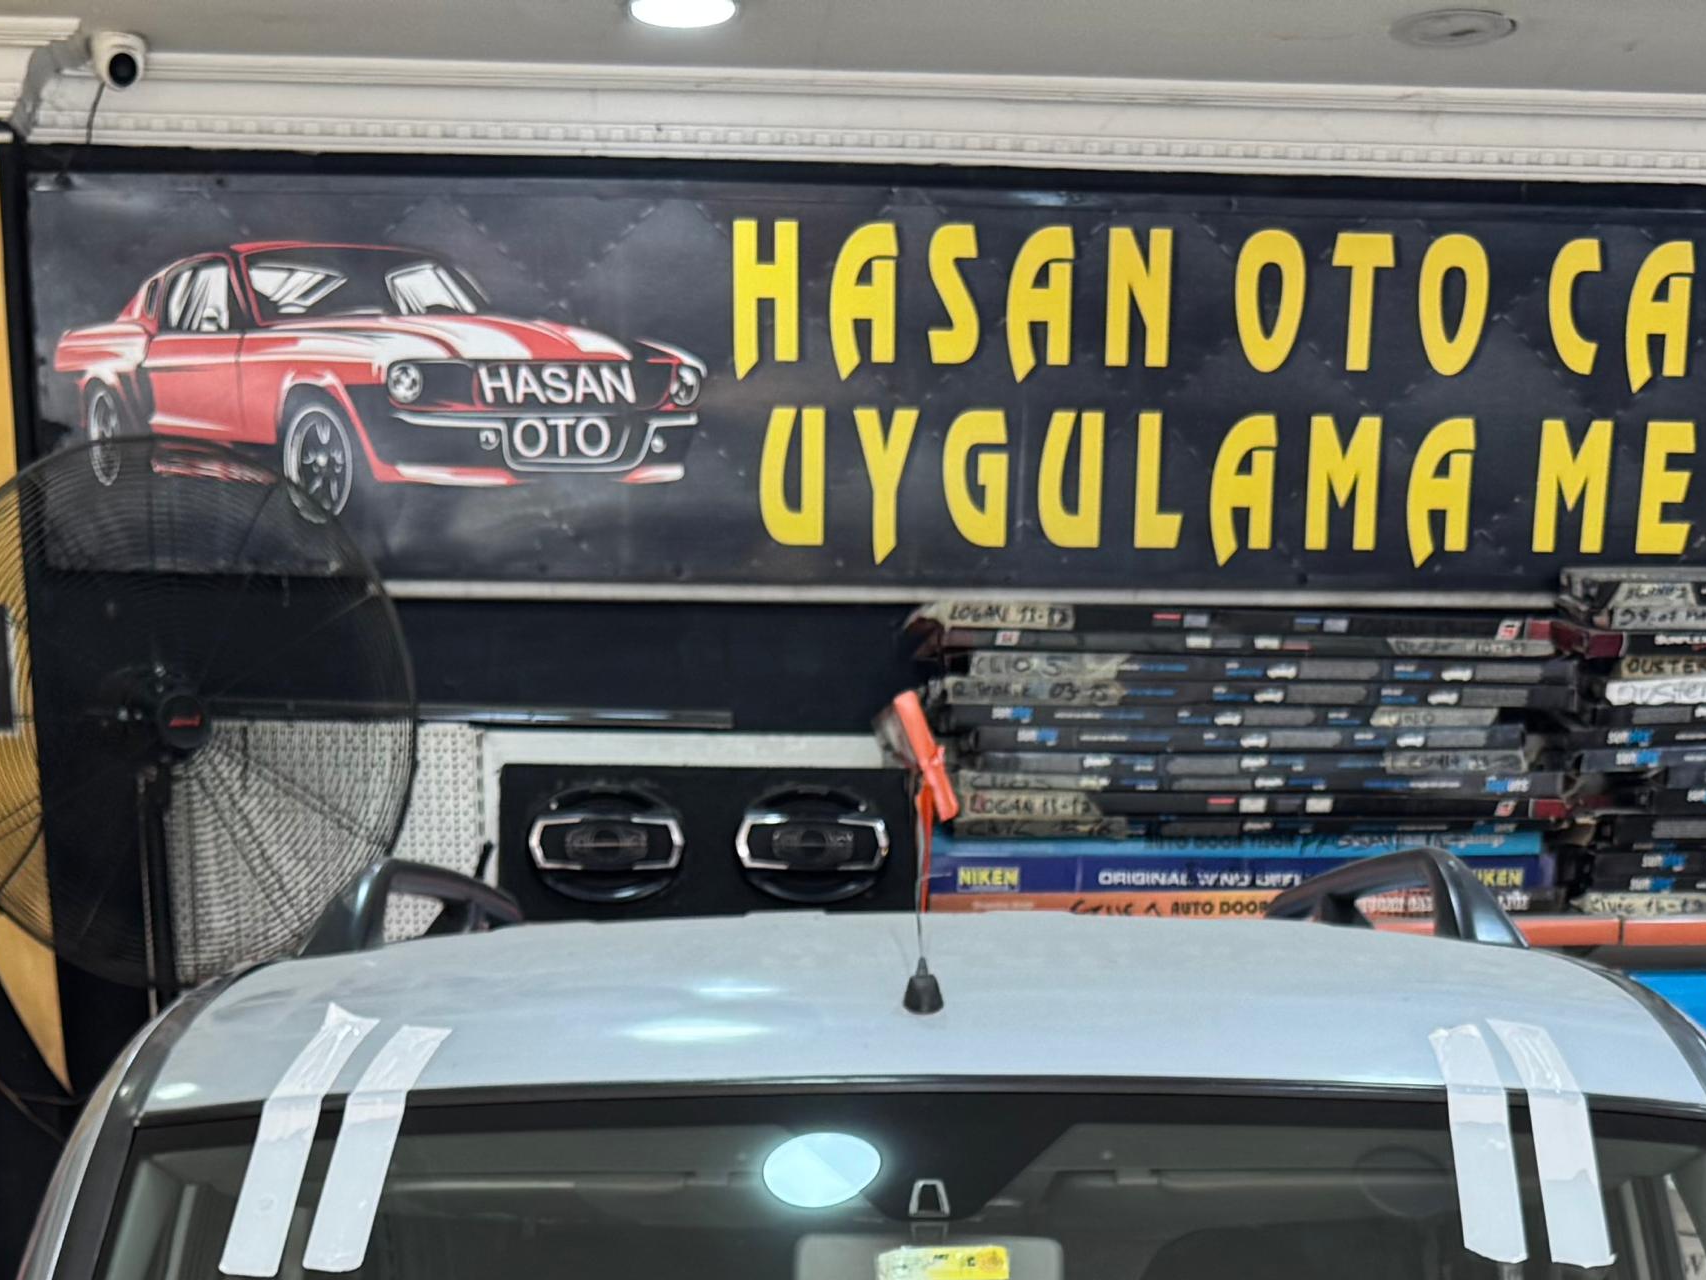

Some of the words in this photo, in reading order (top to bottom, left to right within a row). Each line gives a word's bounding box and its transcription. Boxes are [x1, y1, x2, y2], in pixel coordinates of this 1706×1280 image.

[734, 219, 1174, 382] HASAN
[1236, 229, 1490, 377] OTO
[478, 363, 637, 404] HASAN
[512, 417, 612, 458] OTO
[762, 407, 1477, 567] UYGULAMA
[957, 868, 1018, 885] NIKEN
